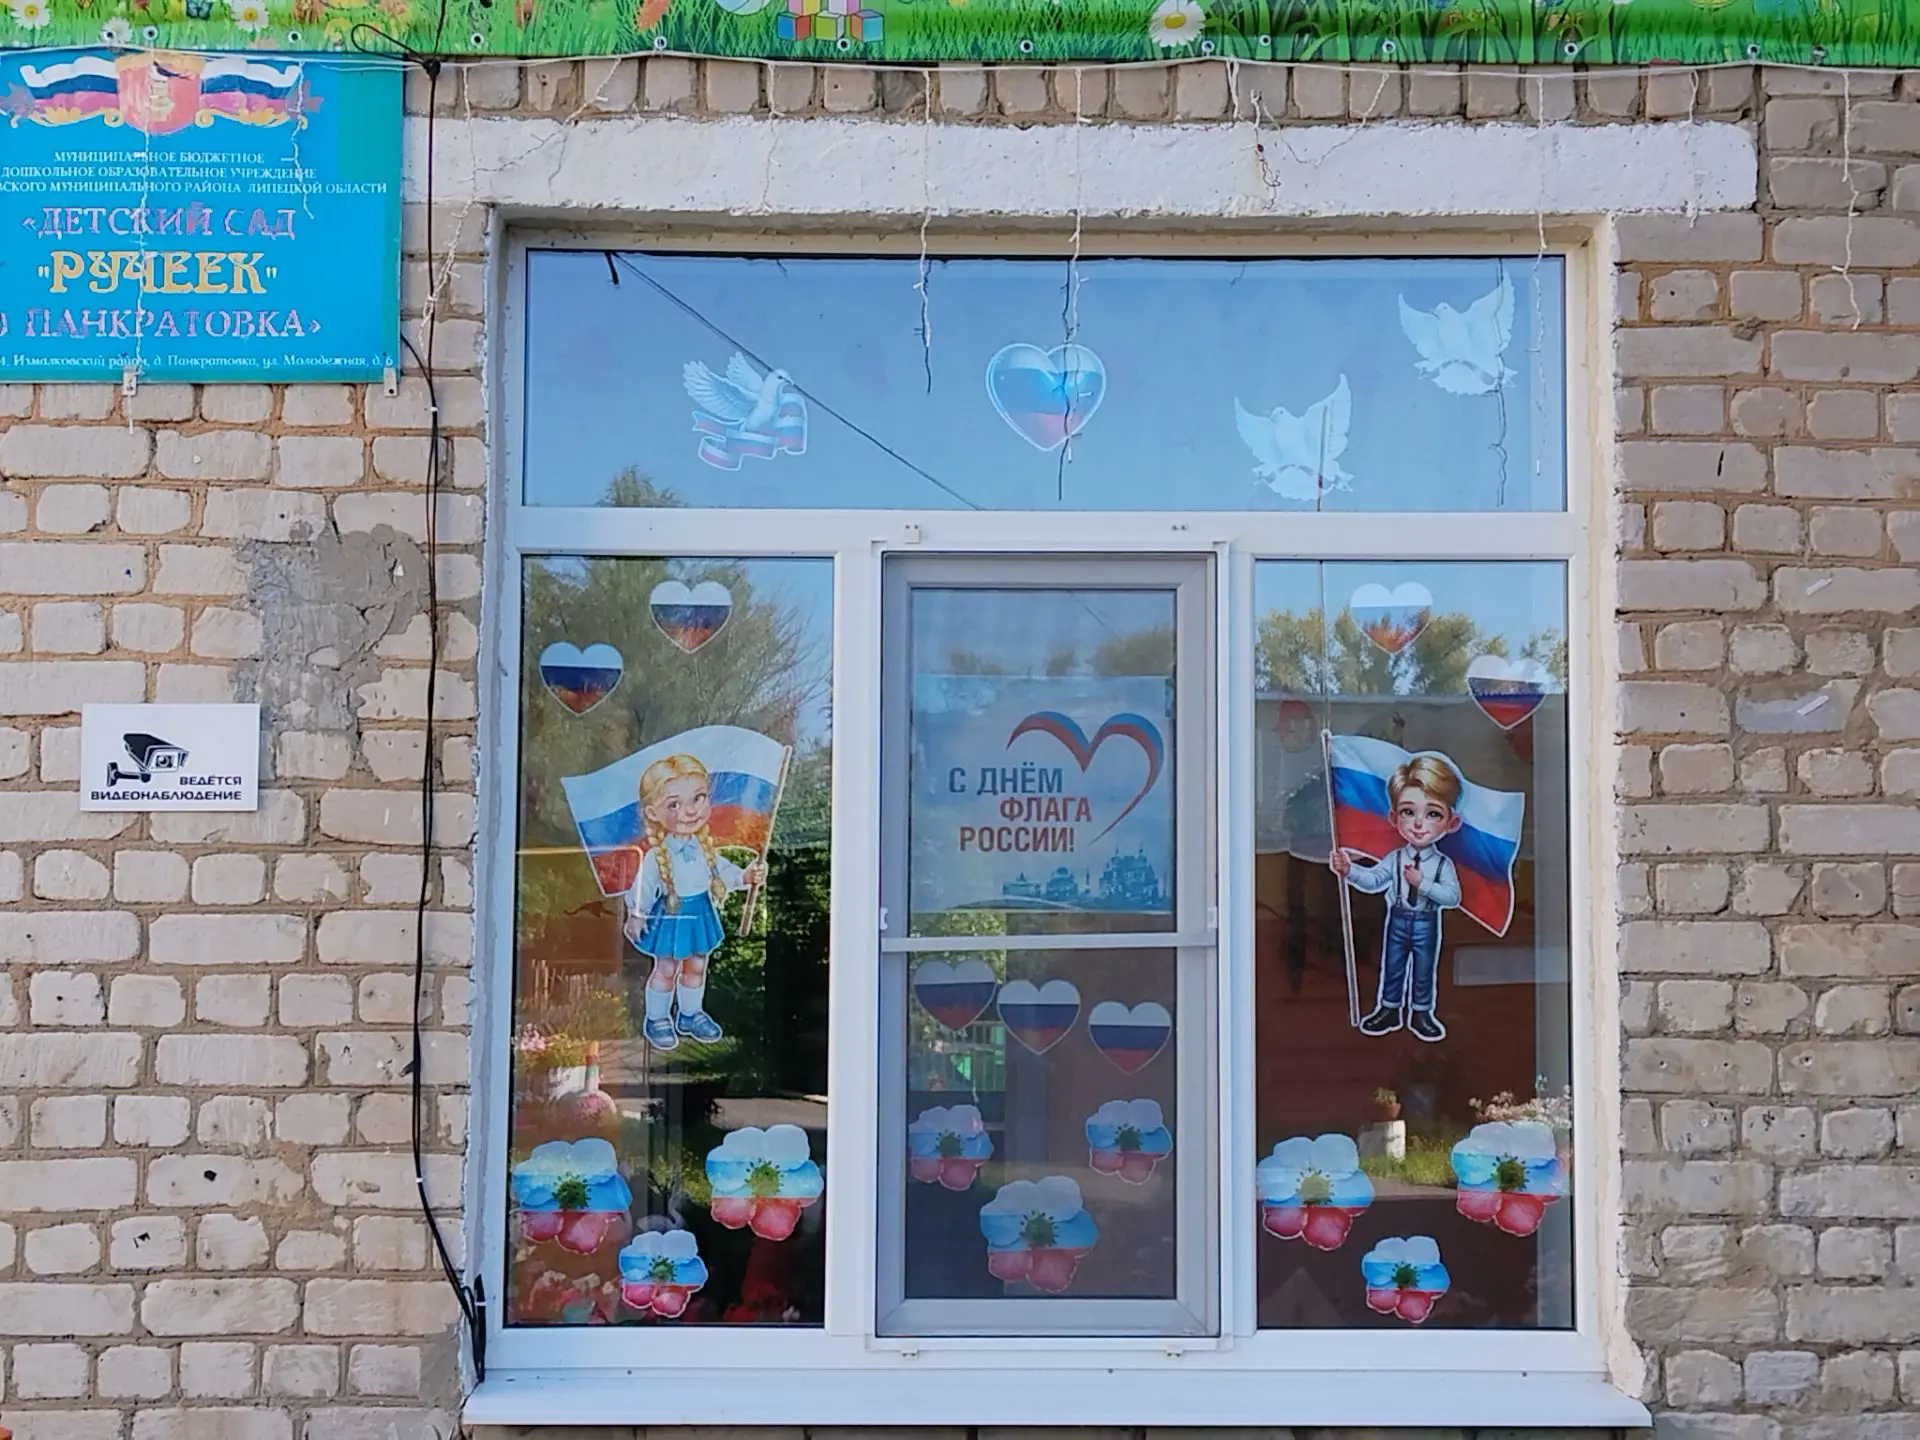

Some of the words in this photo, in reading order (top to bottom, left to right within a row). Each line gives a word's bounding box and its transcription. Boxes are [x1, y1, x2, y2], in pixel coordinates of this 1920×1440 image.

[55, 151, 176, 162] МУНИЦИПАЛЬНОЕ
[180, 152, 264, 164] БЮДЖЕТНОЕ
[2, 166, 95, 177] ДОШКОЛЬНОЕ
[98, 166, 227, 178] ОБРАЗОВАТЕЛЬНОЕ
[231, 168, 316, 180] УЧРЕЖДЕНИЕ
[50, 181, 181, 193] МУНИЦИПАЛЬНОГО
[185, 180, 241, 193] РАЙОНА
[248, 181, 322, 195] ЛИПЕЦКОЙ
[325, 183, 387, 194] ОБЛАСТИ
[22, 201, 213, 240] «ДЕТСКИЙ
[224, 207, 296, 240] САД
[24, 309, 321, 338] ПАНКРАТОВКА»
[13, 354, 105, 366] Измалковский
[179, 775, 242, 785] ВЕДЁТСЯ
[949, 767, 967, 793] С
[977, 761, 1063, 795] ДНЁМ
[91, 791, 242, 801] ВИДЕОНАБЛЮДЕНИЕ
[1000, 797, 1092, 822] ФЛАГА
[960, 826, 1075, 852] РОССИИ!
